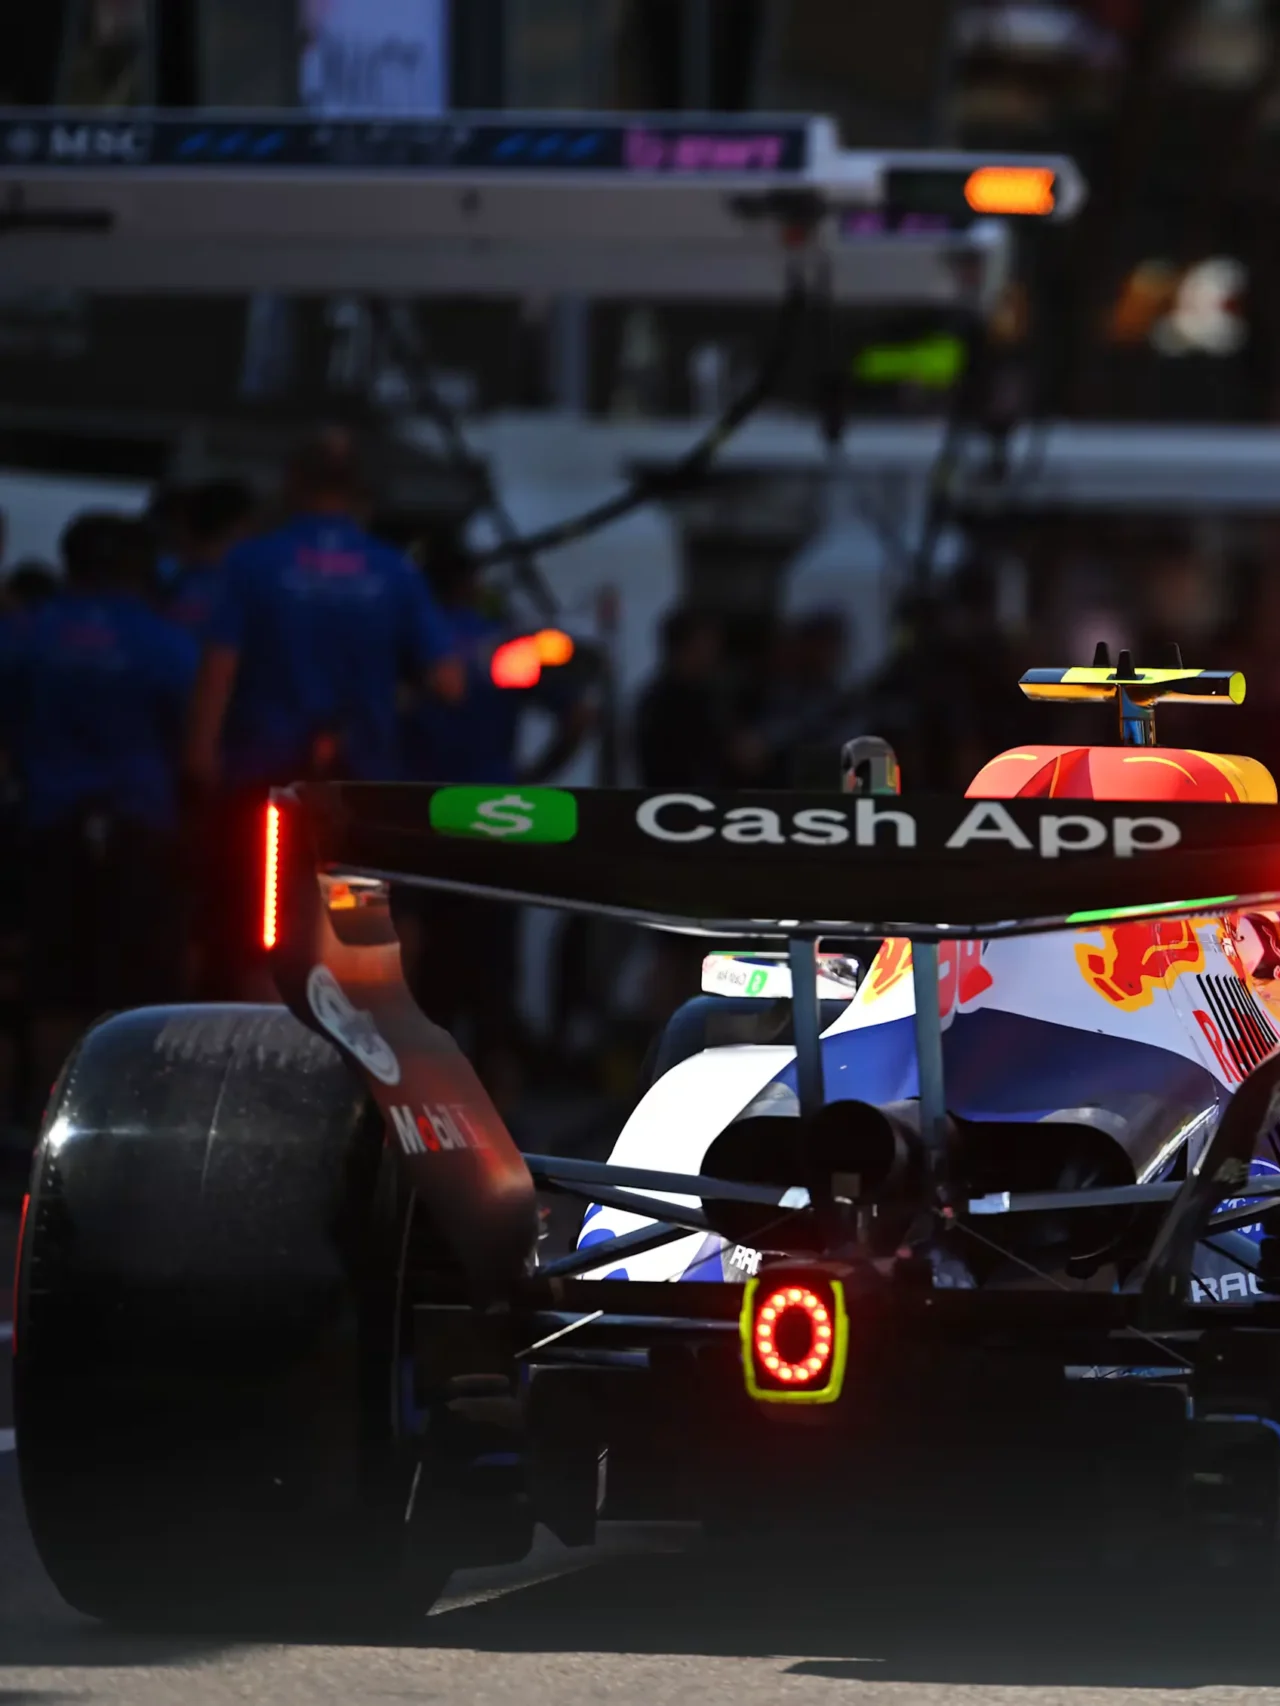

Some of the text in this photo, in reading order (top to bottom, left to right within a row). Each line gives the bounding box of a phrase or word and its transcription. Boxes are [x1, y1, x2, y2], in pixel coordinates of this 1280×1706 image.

[635, 793, 917, 848] Cash
[945, 801, 1182, 858] App
[389, 1104, 467, 1155] Mobil
